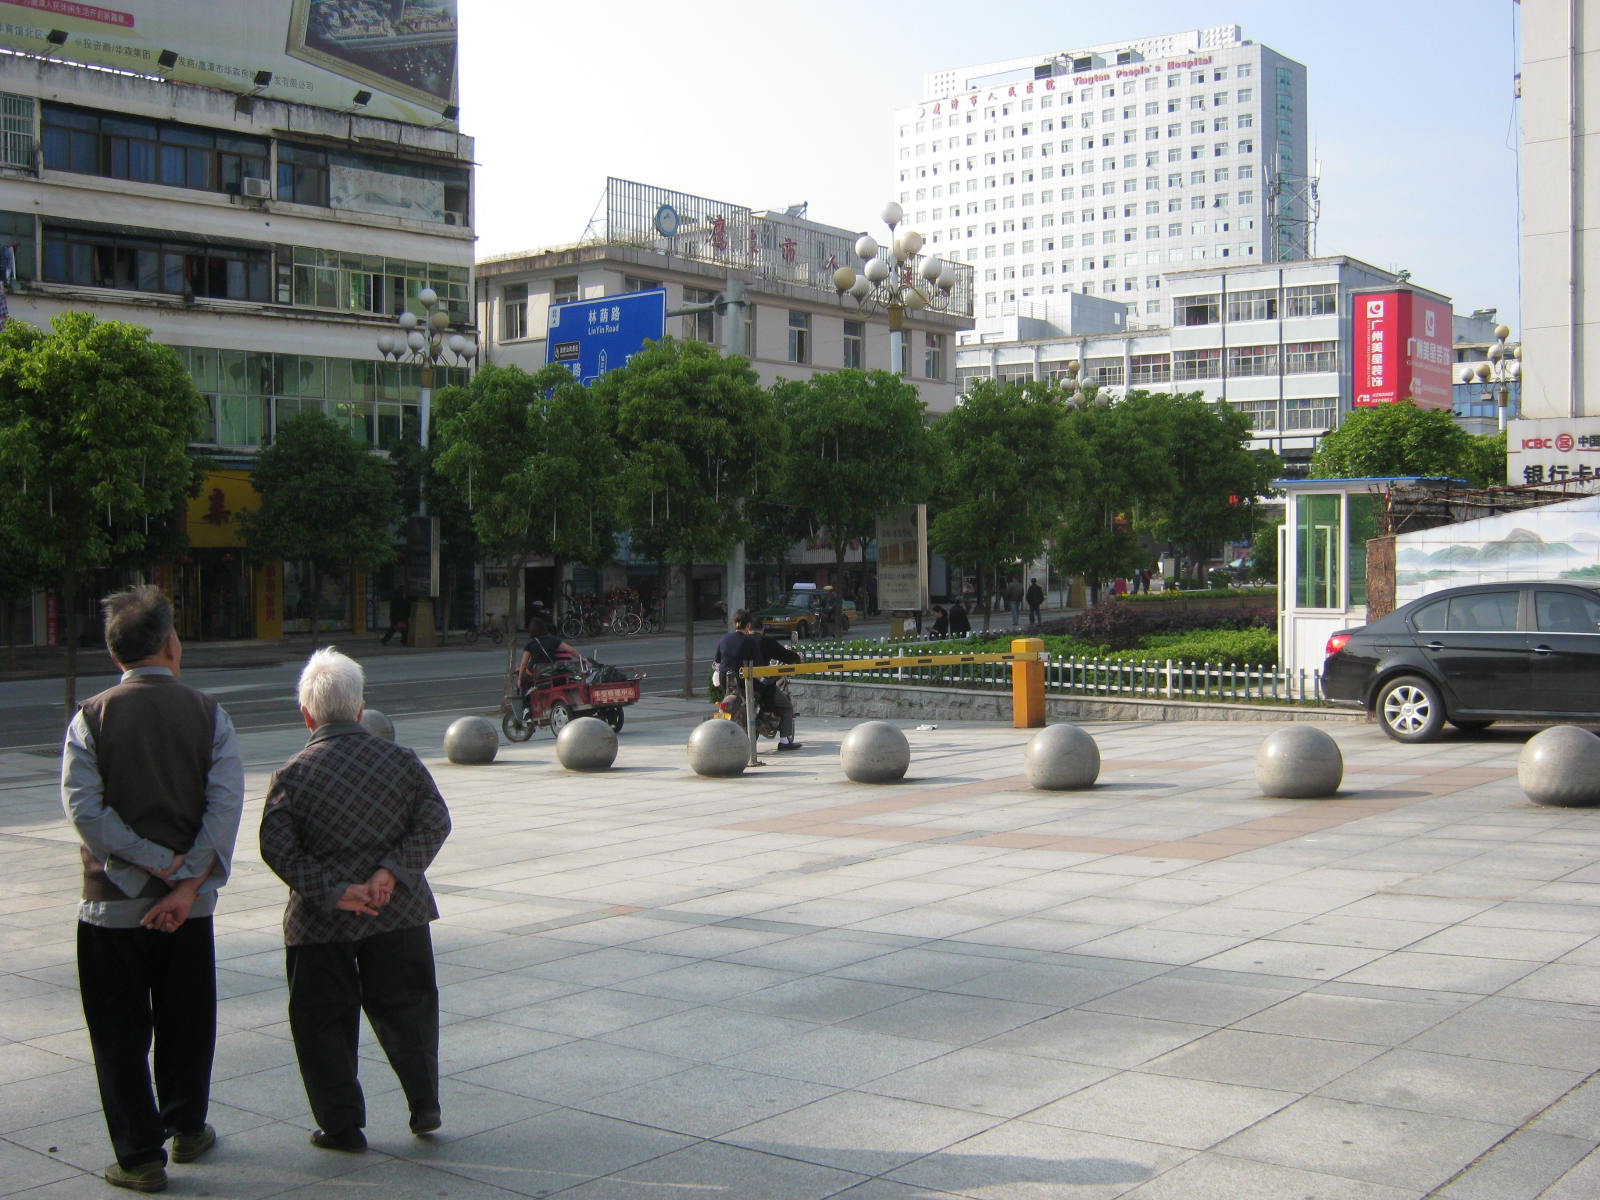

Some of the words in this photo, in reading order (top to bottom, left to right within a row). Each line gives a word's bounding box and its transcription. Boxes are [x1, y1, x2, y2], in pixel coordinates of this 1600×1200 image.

[1073, 73, 1110, 86] Yingtan
[1167, 55, 1212, 70] Hospital
[588, 306, 620, 325] 林荫路
[605, 324, 620, 334] Road
[1522, 438, 1552, 449] ICBC
